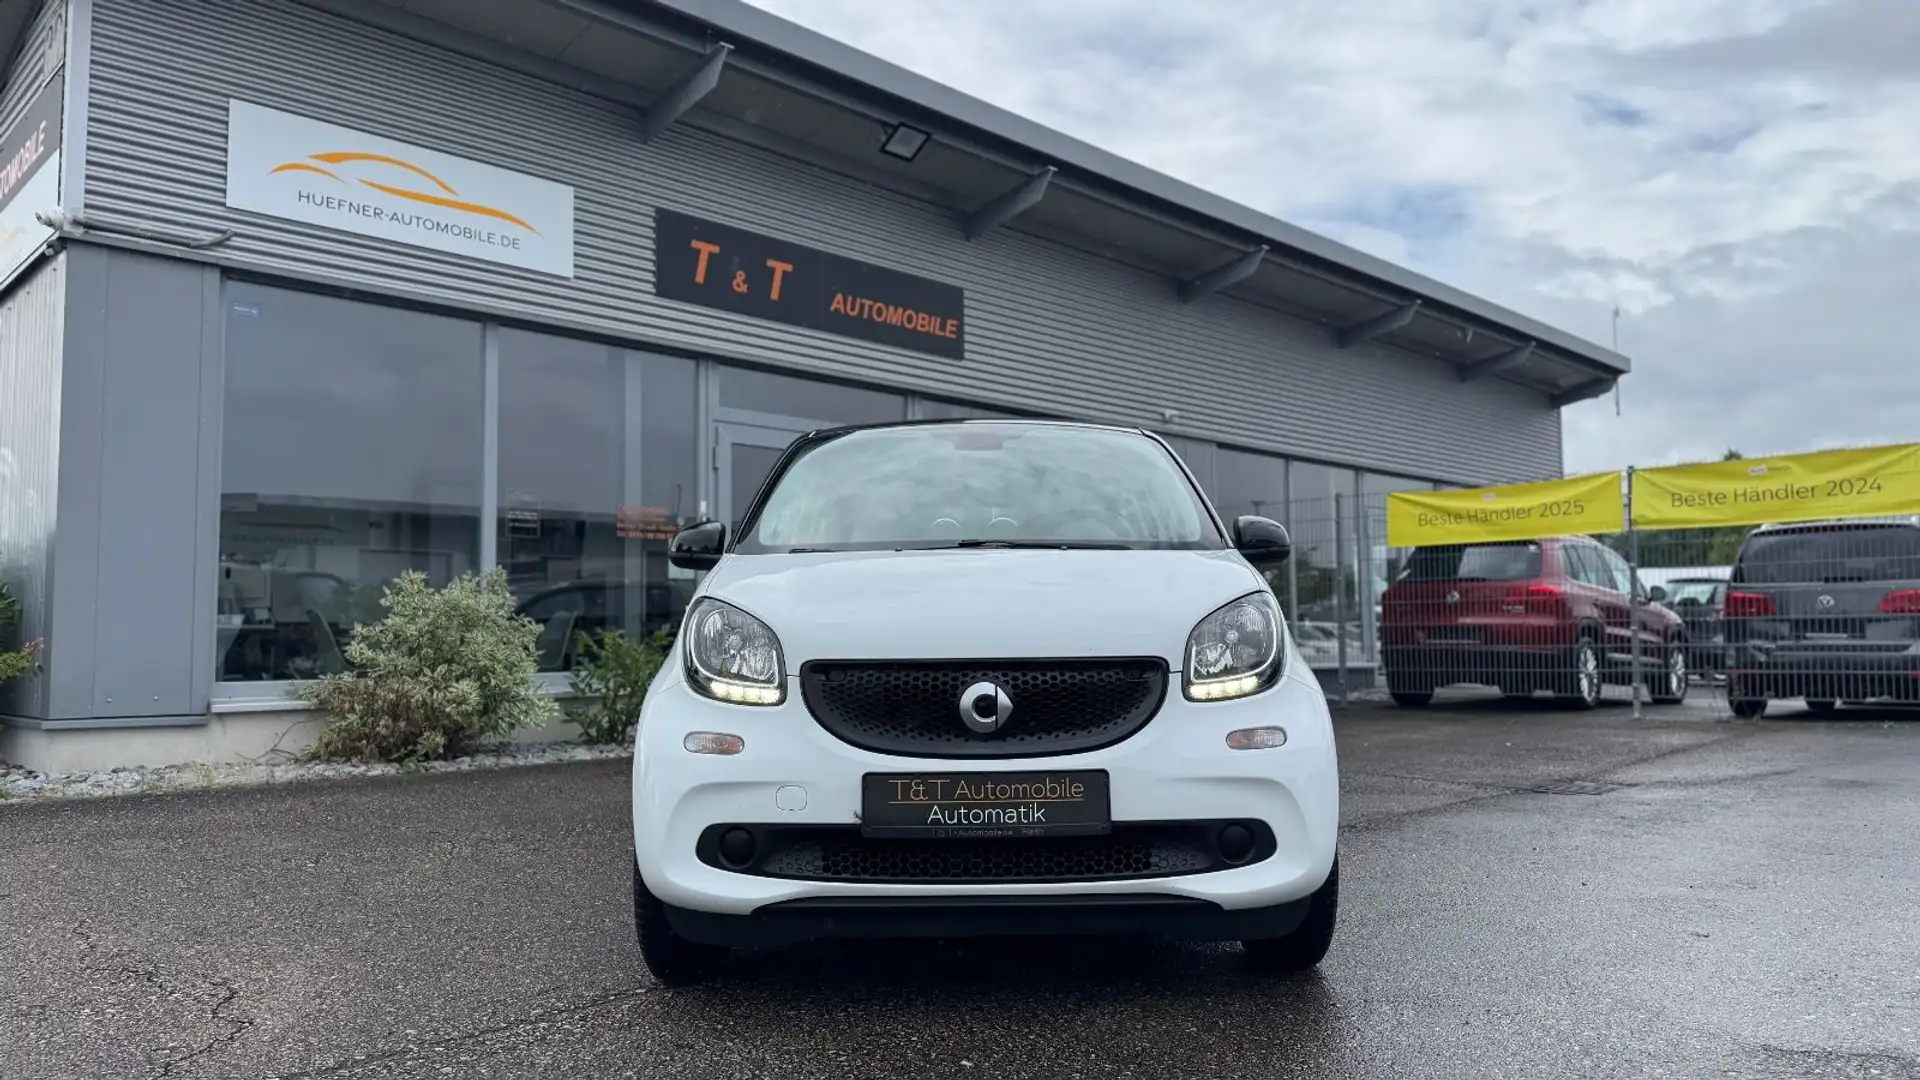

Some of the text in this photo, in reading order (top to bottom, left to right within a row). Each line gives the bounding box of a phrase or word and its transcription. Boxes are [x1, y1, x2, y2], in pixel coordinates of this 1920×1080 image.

[297, 190, 522, 250] HUEFNER-AUTOMOBILE.DE
[690, 239, 958, 339] T & T AUTOMOBILE
[1671, 476, 1883, 508] Beste Händler 2024
[1418, 499, 1585, 527] Beste Händler 2025
[954, 777, 1085, 800] Automobile
[927, 802, 1047, 825] Automatik
